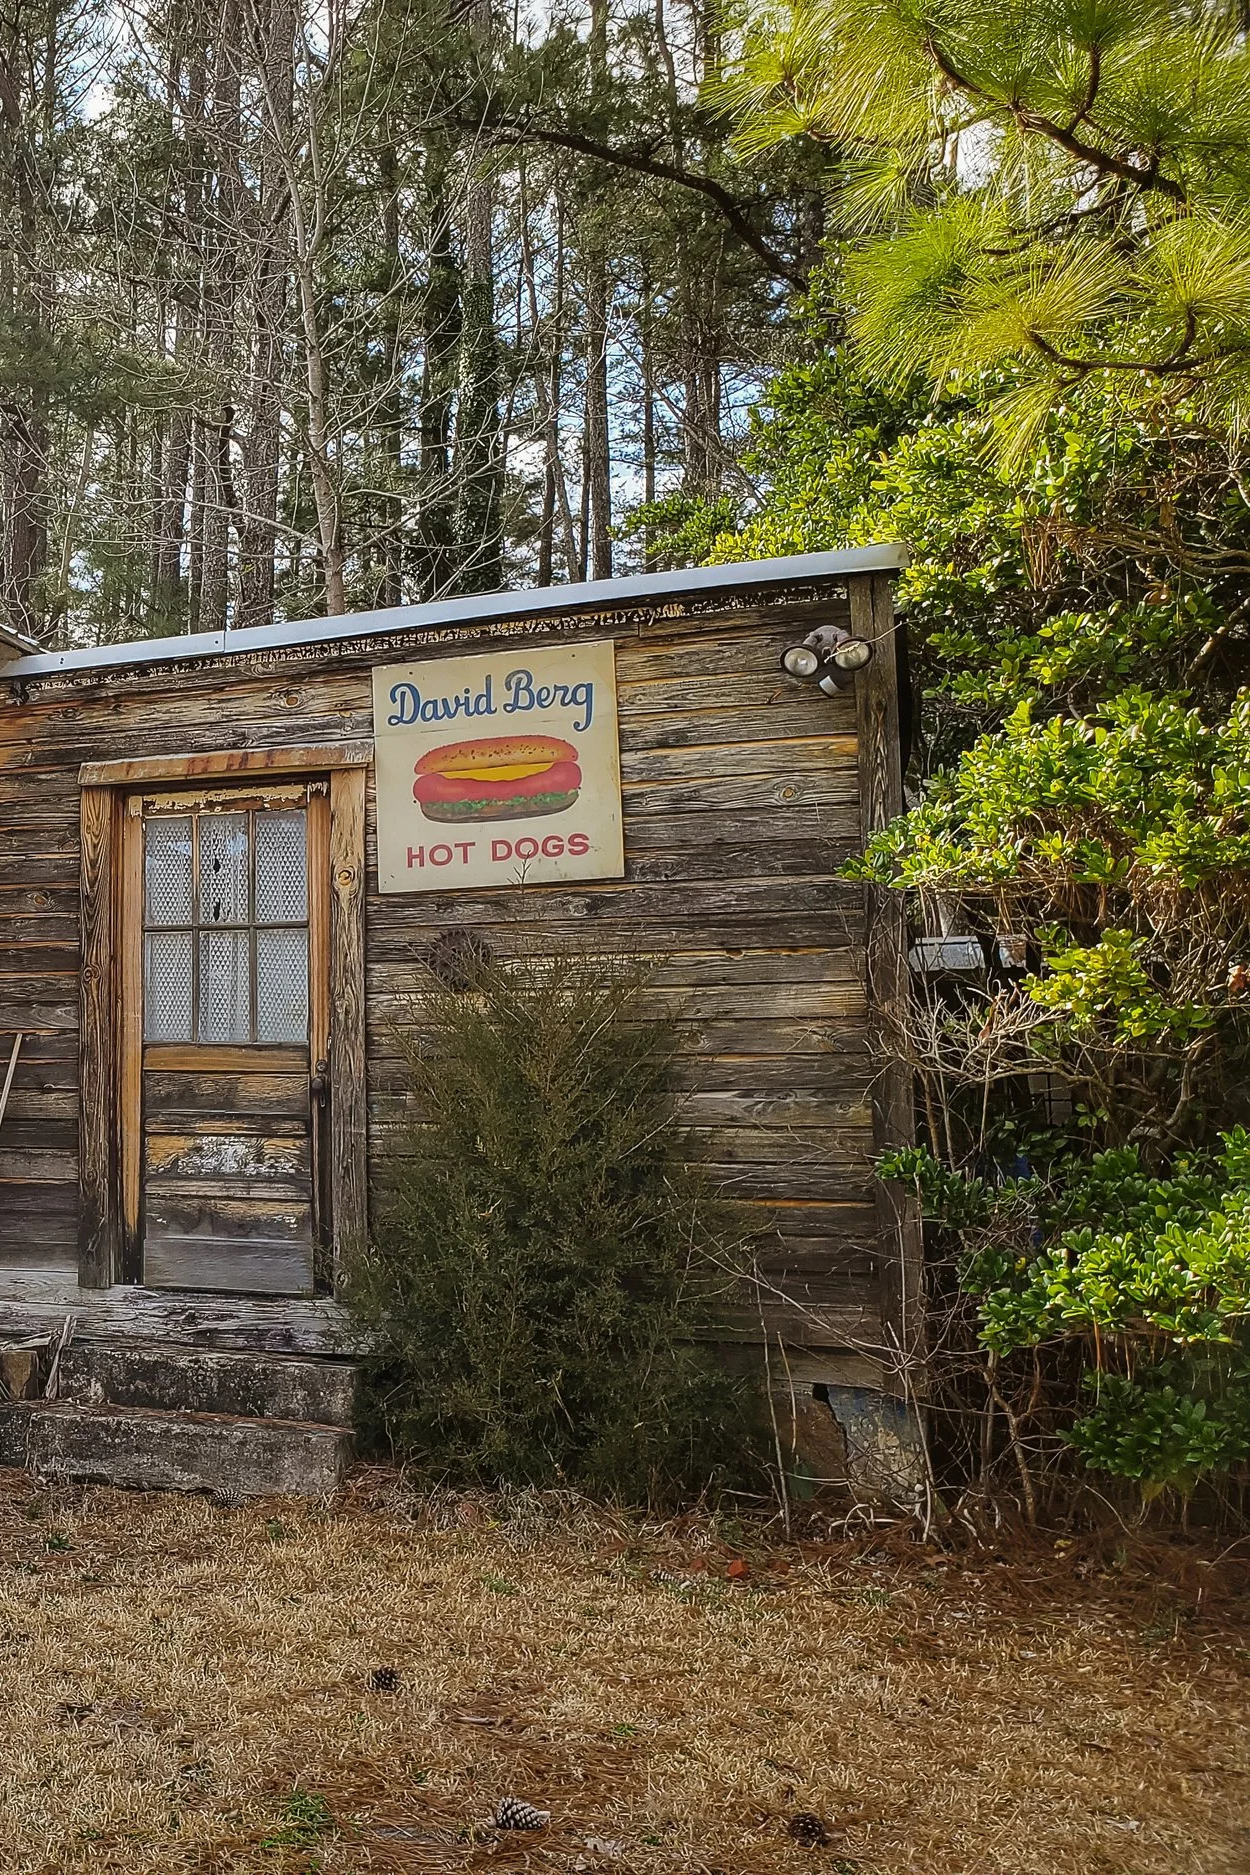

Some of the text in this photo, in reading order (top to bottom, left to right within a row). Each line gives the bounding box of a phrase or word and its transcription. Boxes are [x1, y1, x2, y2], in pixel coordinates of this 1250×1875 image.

[387, 669, 594, 732] David Berg
[406, 833, 591, 868] HOT DOGS
